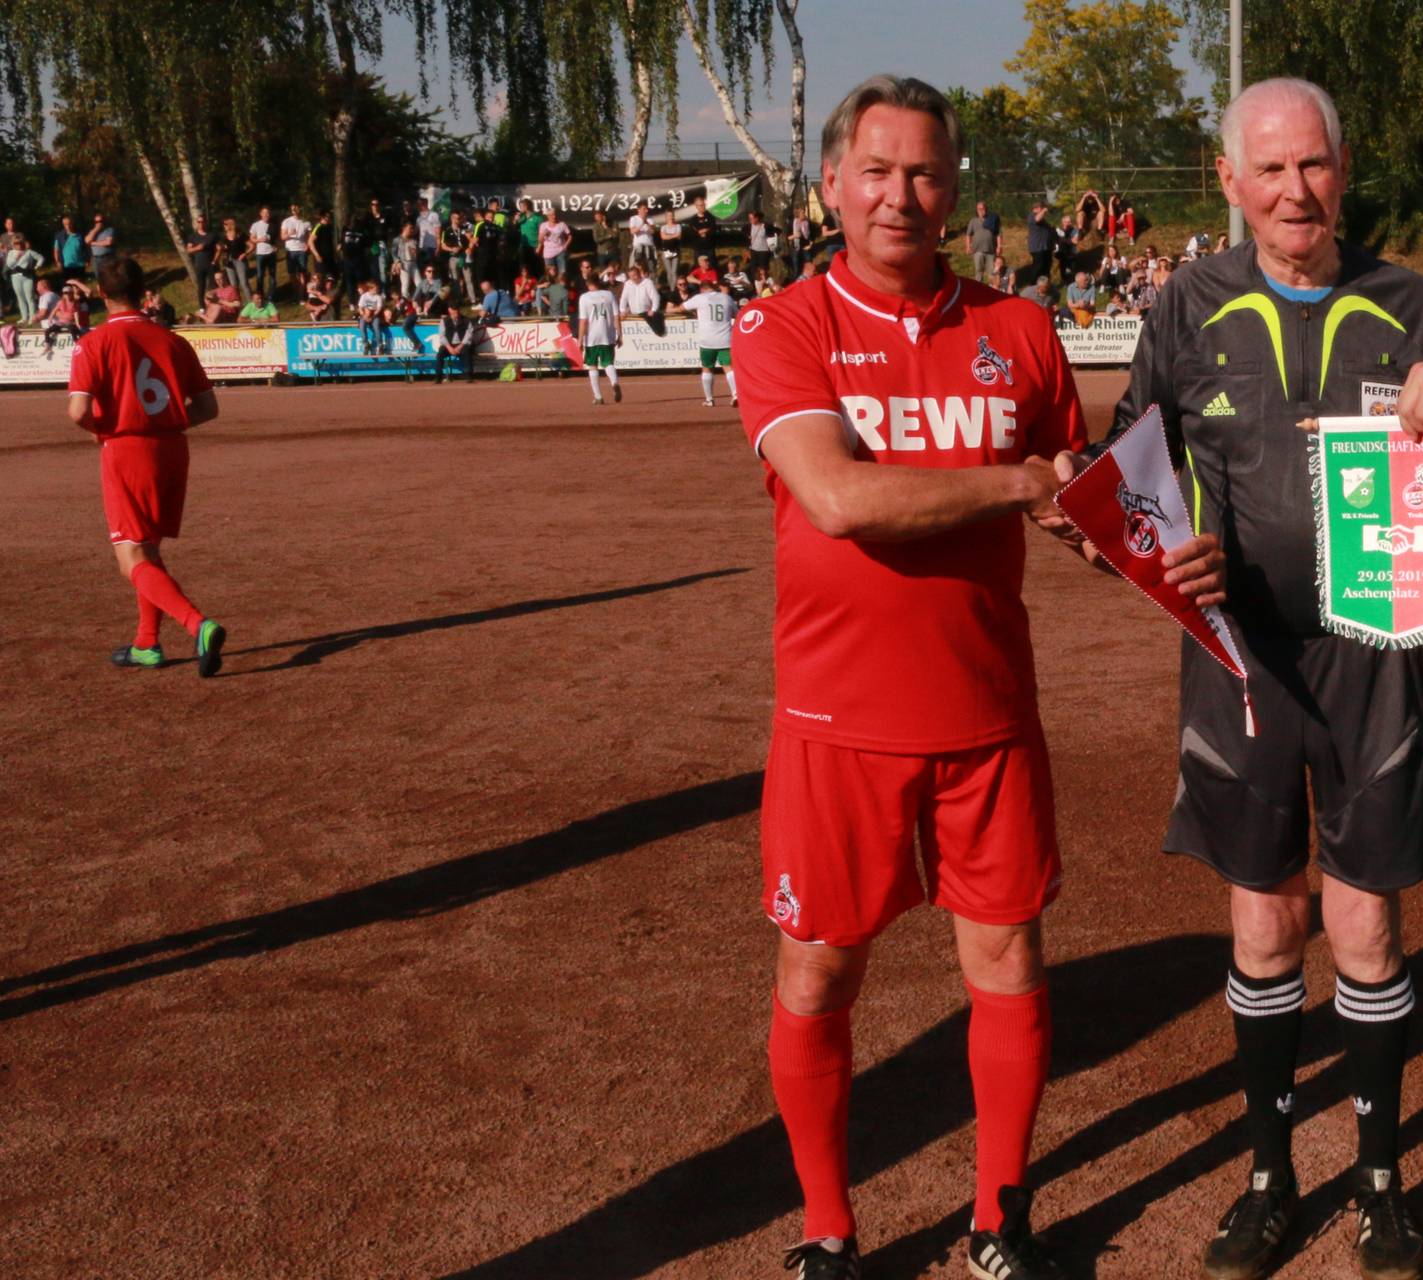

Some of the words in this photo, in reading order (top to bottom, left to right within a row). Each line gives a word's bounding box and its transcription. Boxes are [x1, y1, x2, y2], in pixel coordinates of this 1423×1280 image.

[560, 193, 640, 212] 1927/32
[647, 195, 662, 209] e.
[708, 303, 725, 321] 16
[1094, 319, 1137, 329] Rhiem
[302, 333, 355, 351] SPORT
[1059, 333, 1084, 341] nerei
[1088, 333, 1094, 341] &
[1098, 332, 1136, 340] Floristik
[632, 339, 699, 351] Veranstalt
[135, 357, 170, 416] 6
[1202, 407, 1236, 416] adidas
[840, 396, 1016, 451] REWE
[1342, 587, 1419, 602] Aschenplatz
